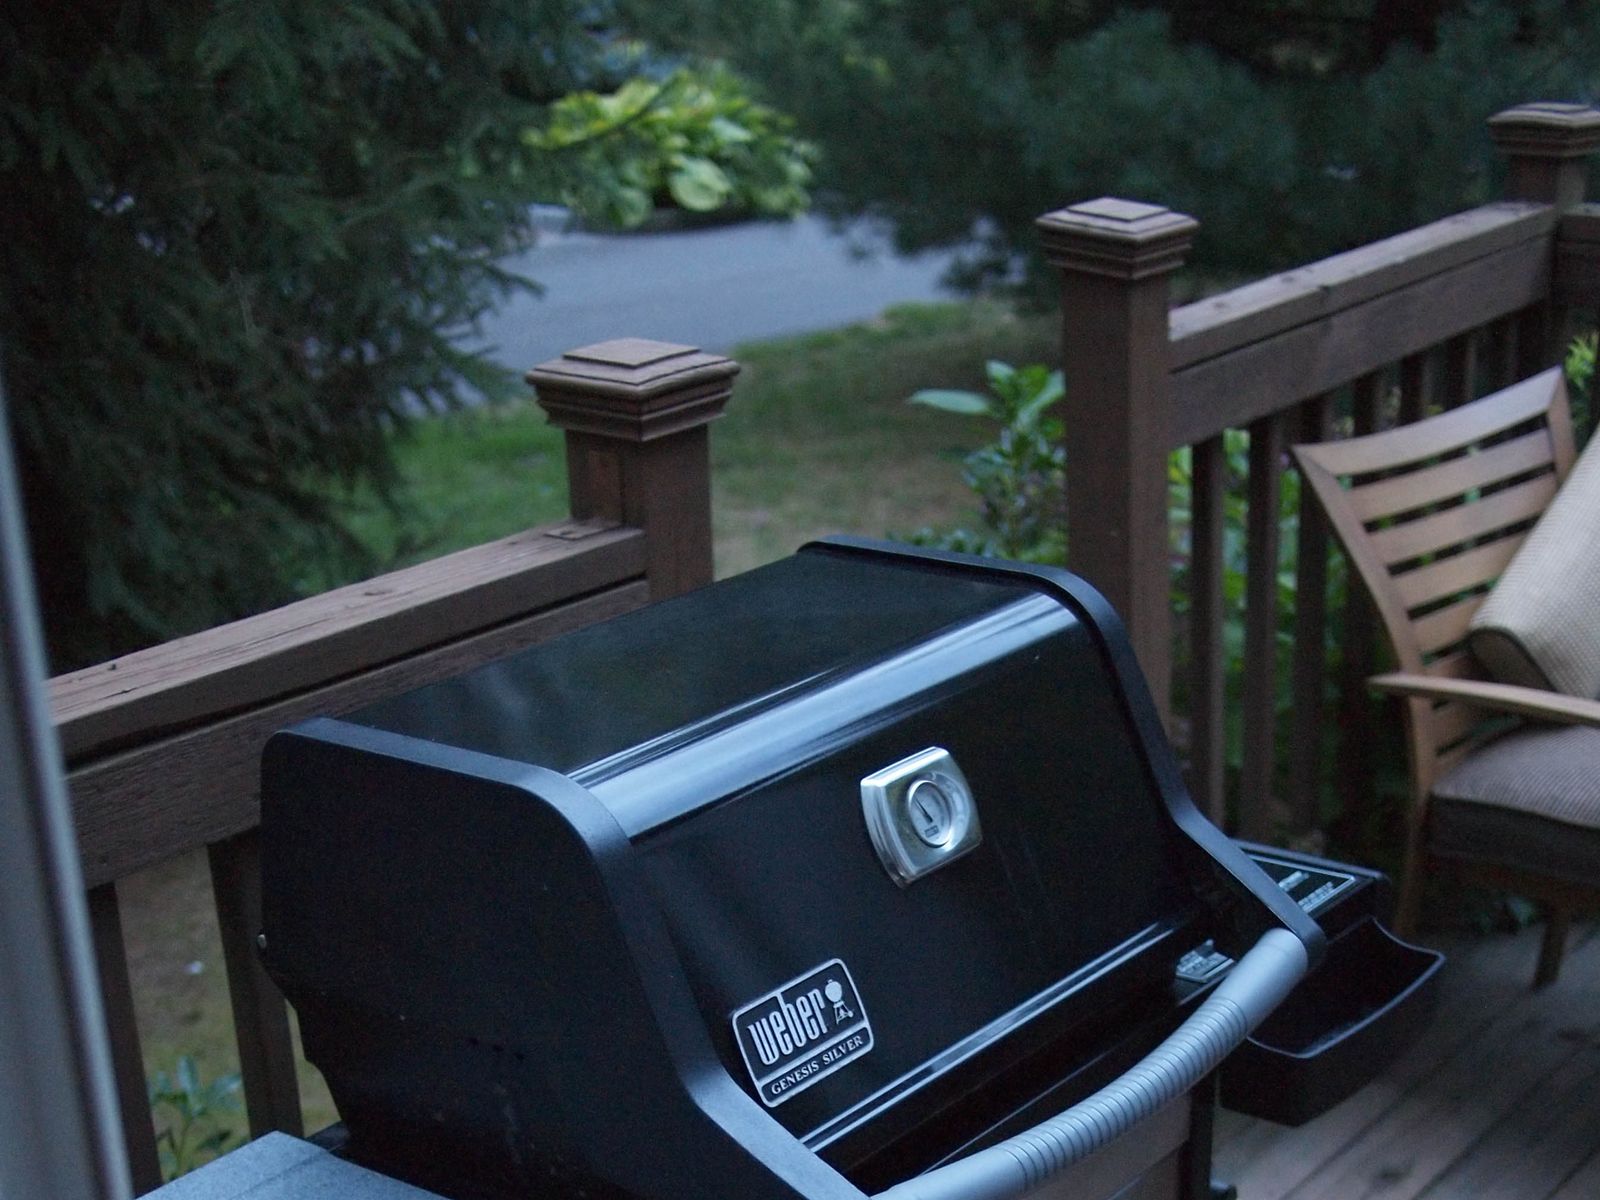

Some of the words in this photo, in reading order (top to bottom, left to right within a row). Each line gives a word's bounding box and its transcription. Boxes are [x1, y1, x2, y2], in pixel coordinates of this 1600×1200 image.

[747, 988, 828, 1065] weber
[771, 1060, 820, 1095] GENESIS
[822, 1035, 863, 1065] SILVER
